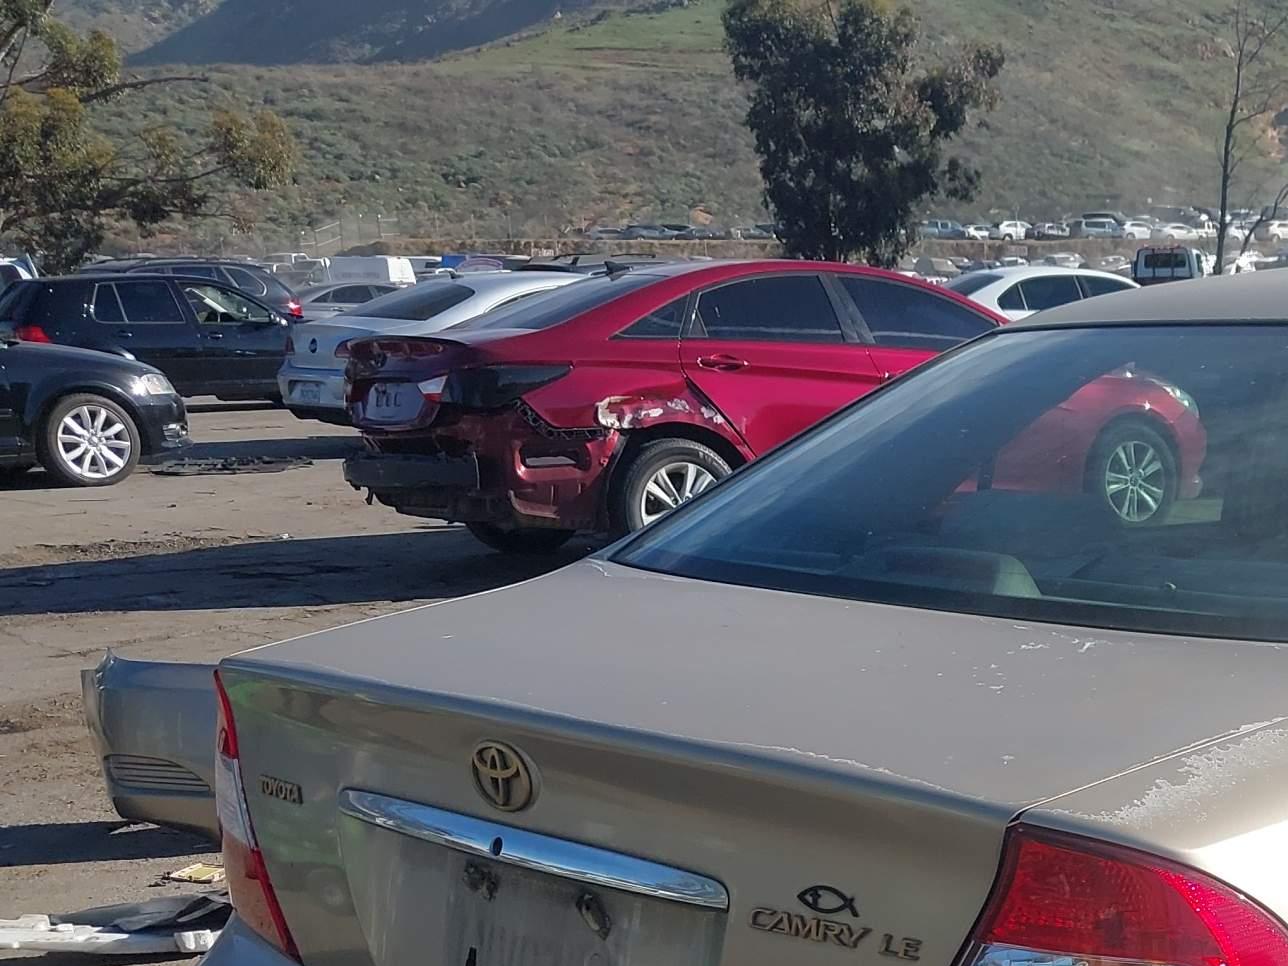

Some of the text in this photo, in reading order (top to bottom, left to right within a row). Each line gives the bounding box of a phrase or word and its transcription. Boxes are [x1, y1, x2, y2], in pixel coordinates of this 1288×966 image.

[256, 774, 304, 805] TOYOTA
[750, 907, 923, 961] CAMRY LE
